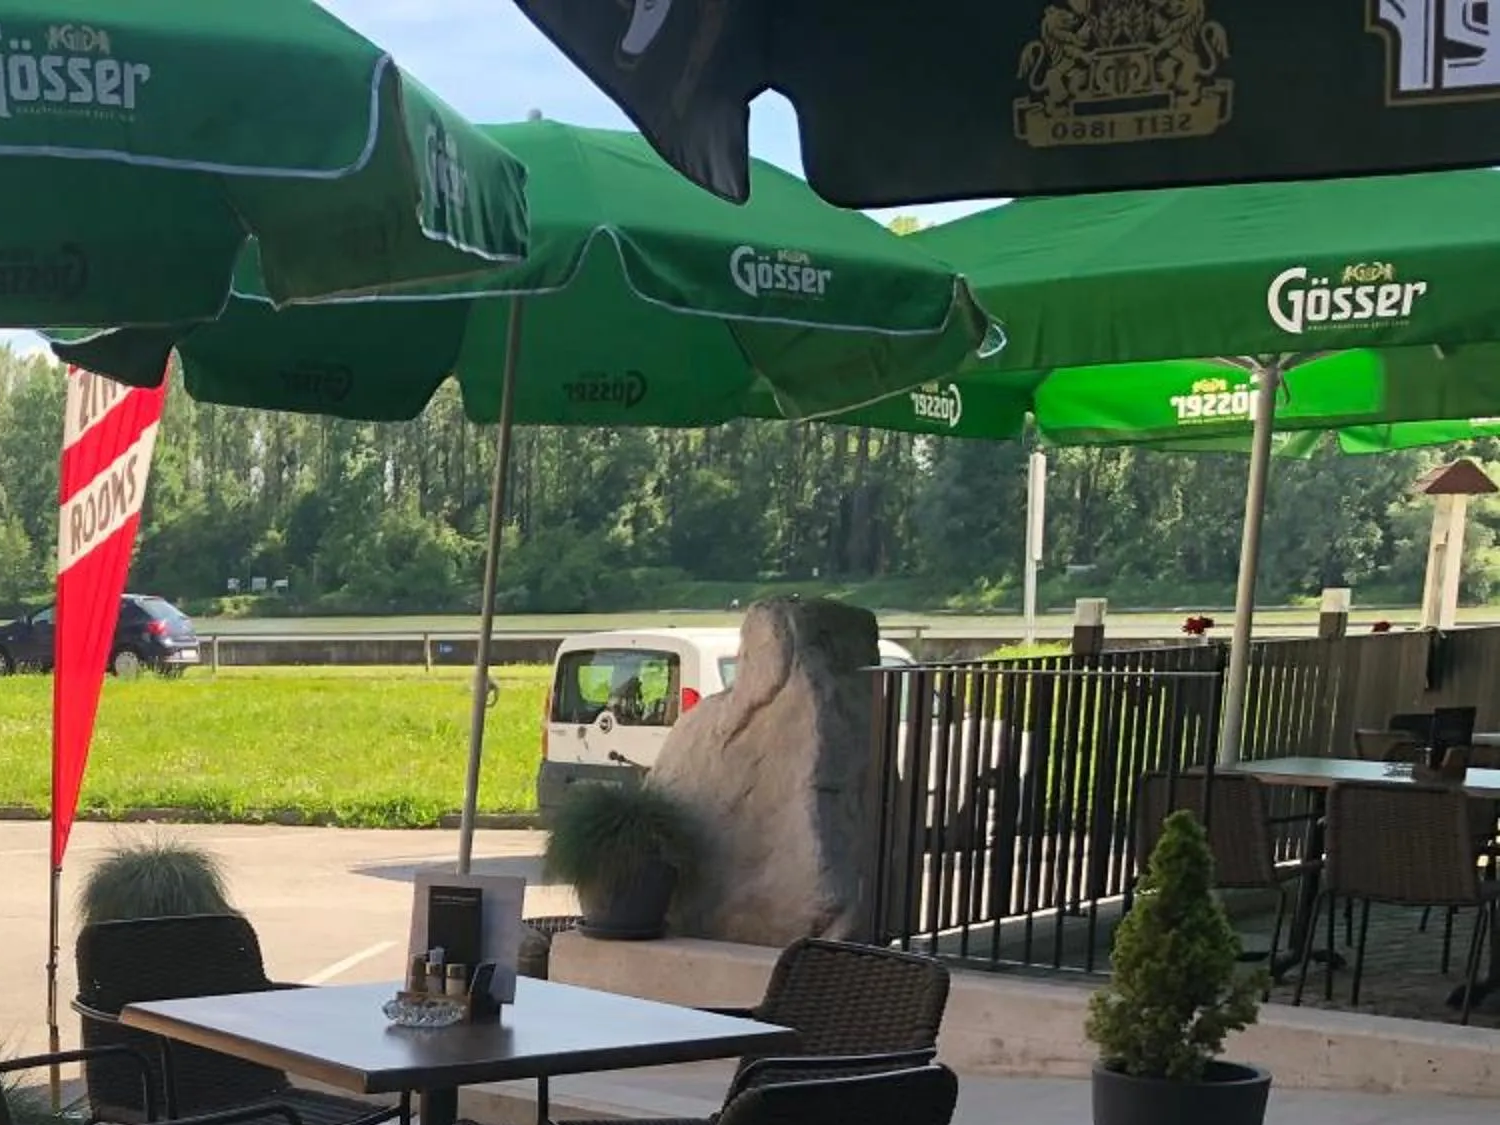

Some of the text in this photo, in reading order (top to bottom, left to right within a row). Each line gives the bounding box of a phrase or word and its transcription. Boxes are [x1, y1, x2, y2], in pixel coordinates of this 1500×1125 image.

[730, 245, 832, 298] Gösser
[1266, 267, 1427, 334] Gösser
[70, 452, 138, 555] ROOMS
